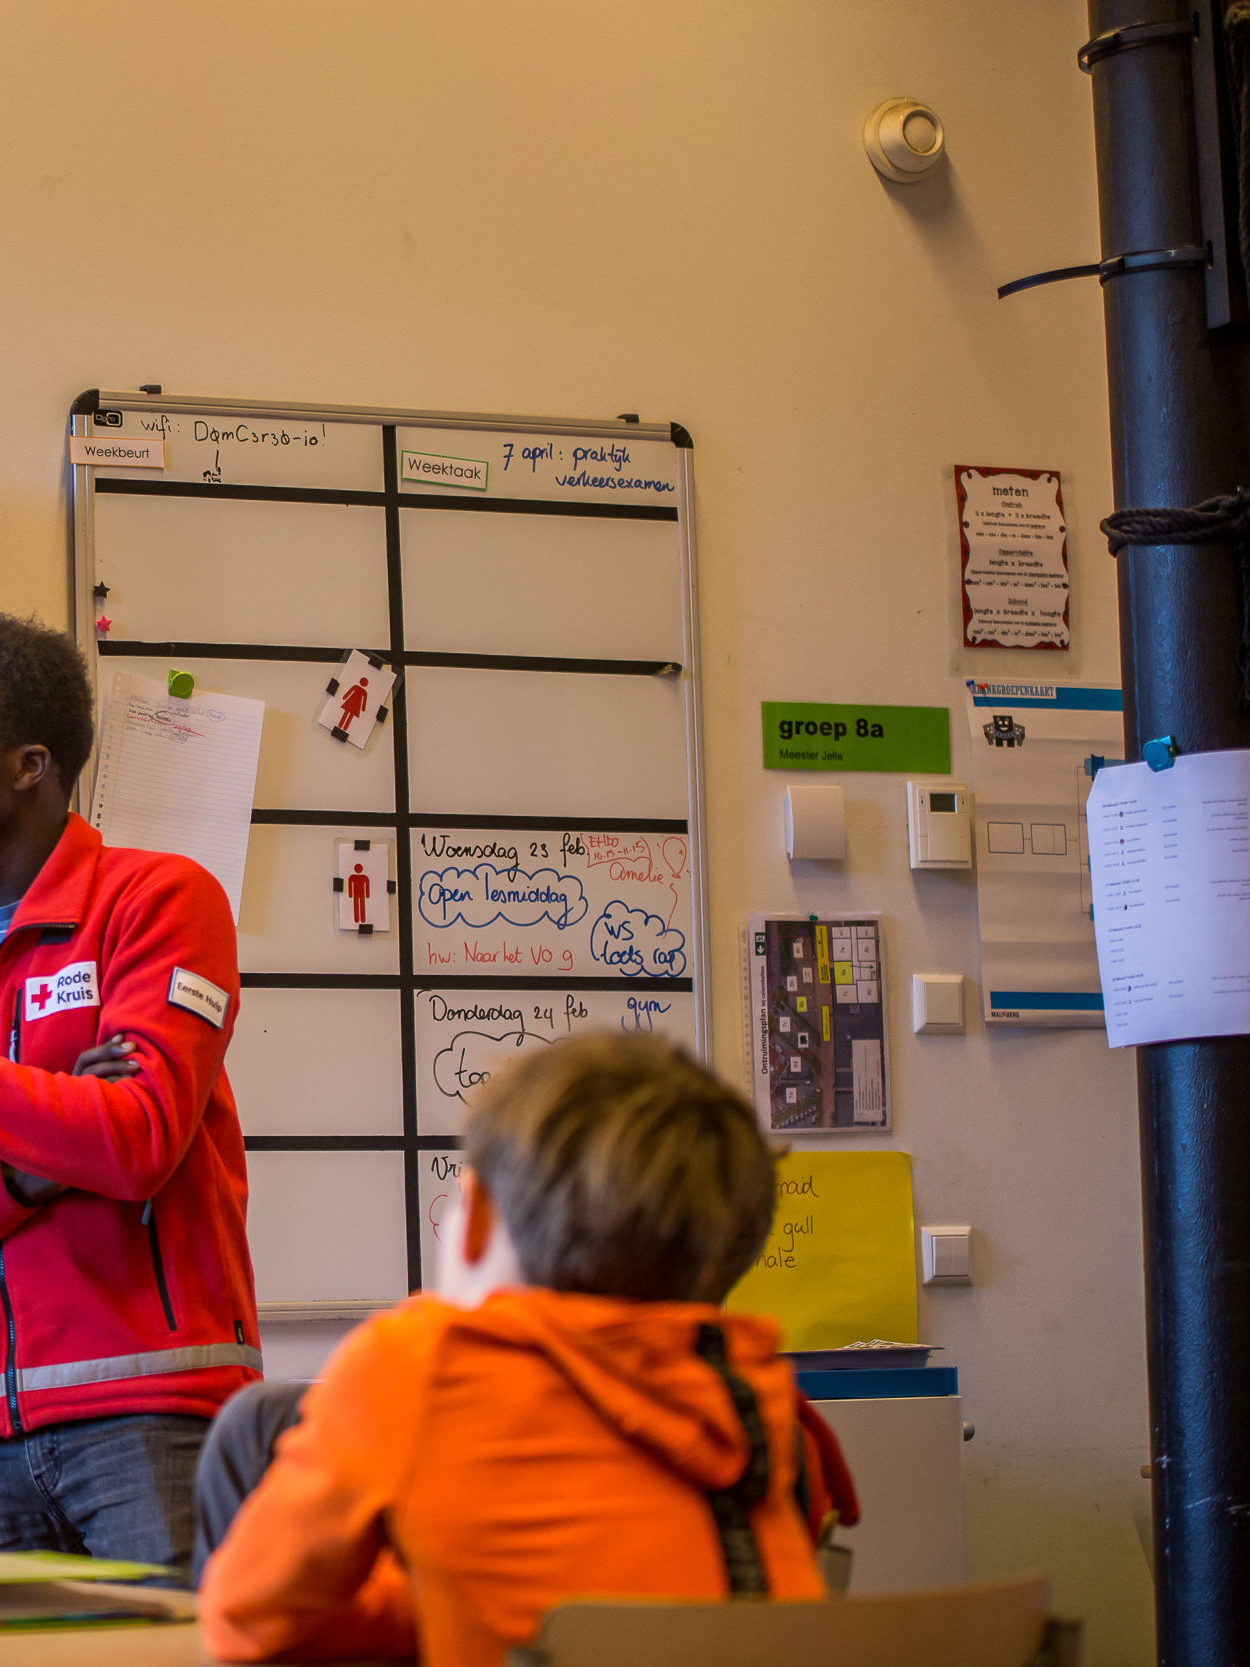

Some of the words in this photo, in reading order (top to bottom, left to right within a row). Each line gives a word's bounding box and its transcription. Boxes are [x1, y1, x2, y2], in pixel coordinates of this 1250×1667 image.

[85, 445, 150, 459] Weekbeurt
[502, 443, 514, 471] 7
[408, 457, 482, 480] Weektaak
[555, 470, 675, 492] verkeersexamen
[992, 485, 1029, 498] meten
[972, 684, 1054, 697] KNKGROEPENKAART
[779, 720, 847, 741] groep
[855, 718, 884, 738] 8a
[779, 749, 818, 760] Meester
[821, 751, 843, 761] Jelle
[421, 833, 520, 882] Woensdag
[529, 842, 549, 858] 23
[463, 941, 500, 963] Naar
[503, 941, 522, 964] het
[57, 971, 91, 989] Rode
[56, 988, 94, 1005] Kruis
[176, 981, 205, 1001] Eerste
[205, 994, 223, 1013] Hulp
[429, 994, 525, 1047] Donderdag
[533, 1006, 554, 1029] 24
[563, 994, 588, 1032] feb
[760, 1009, 769, 1075] Ontruimingsplan
